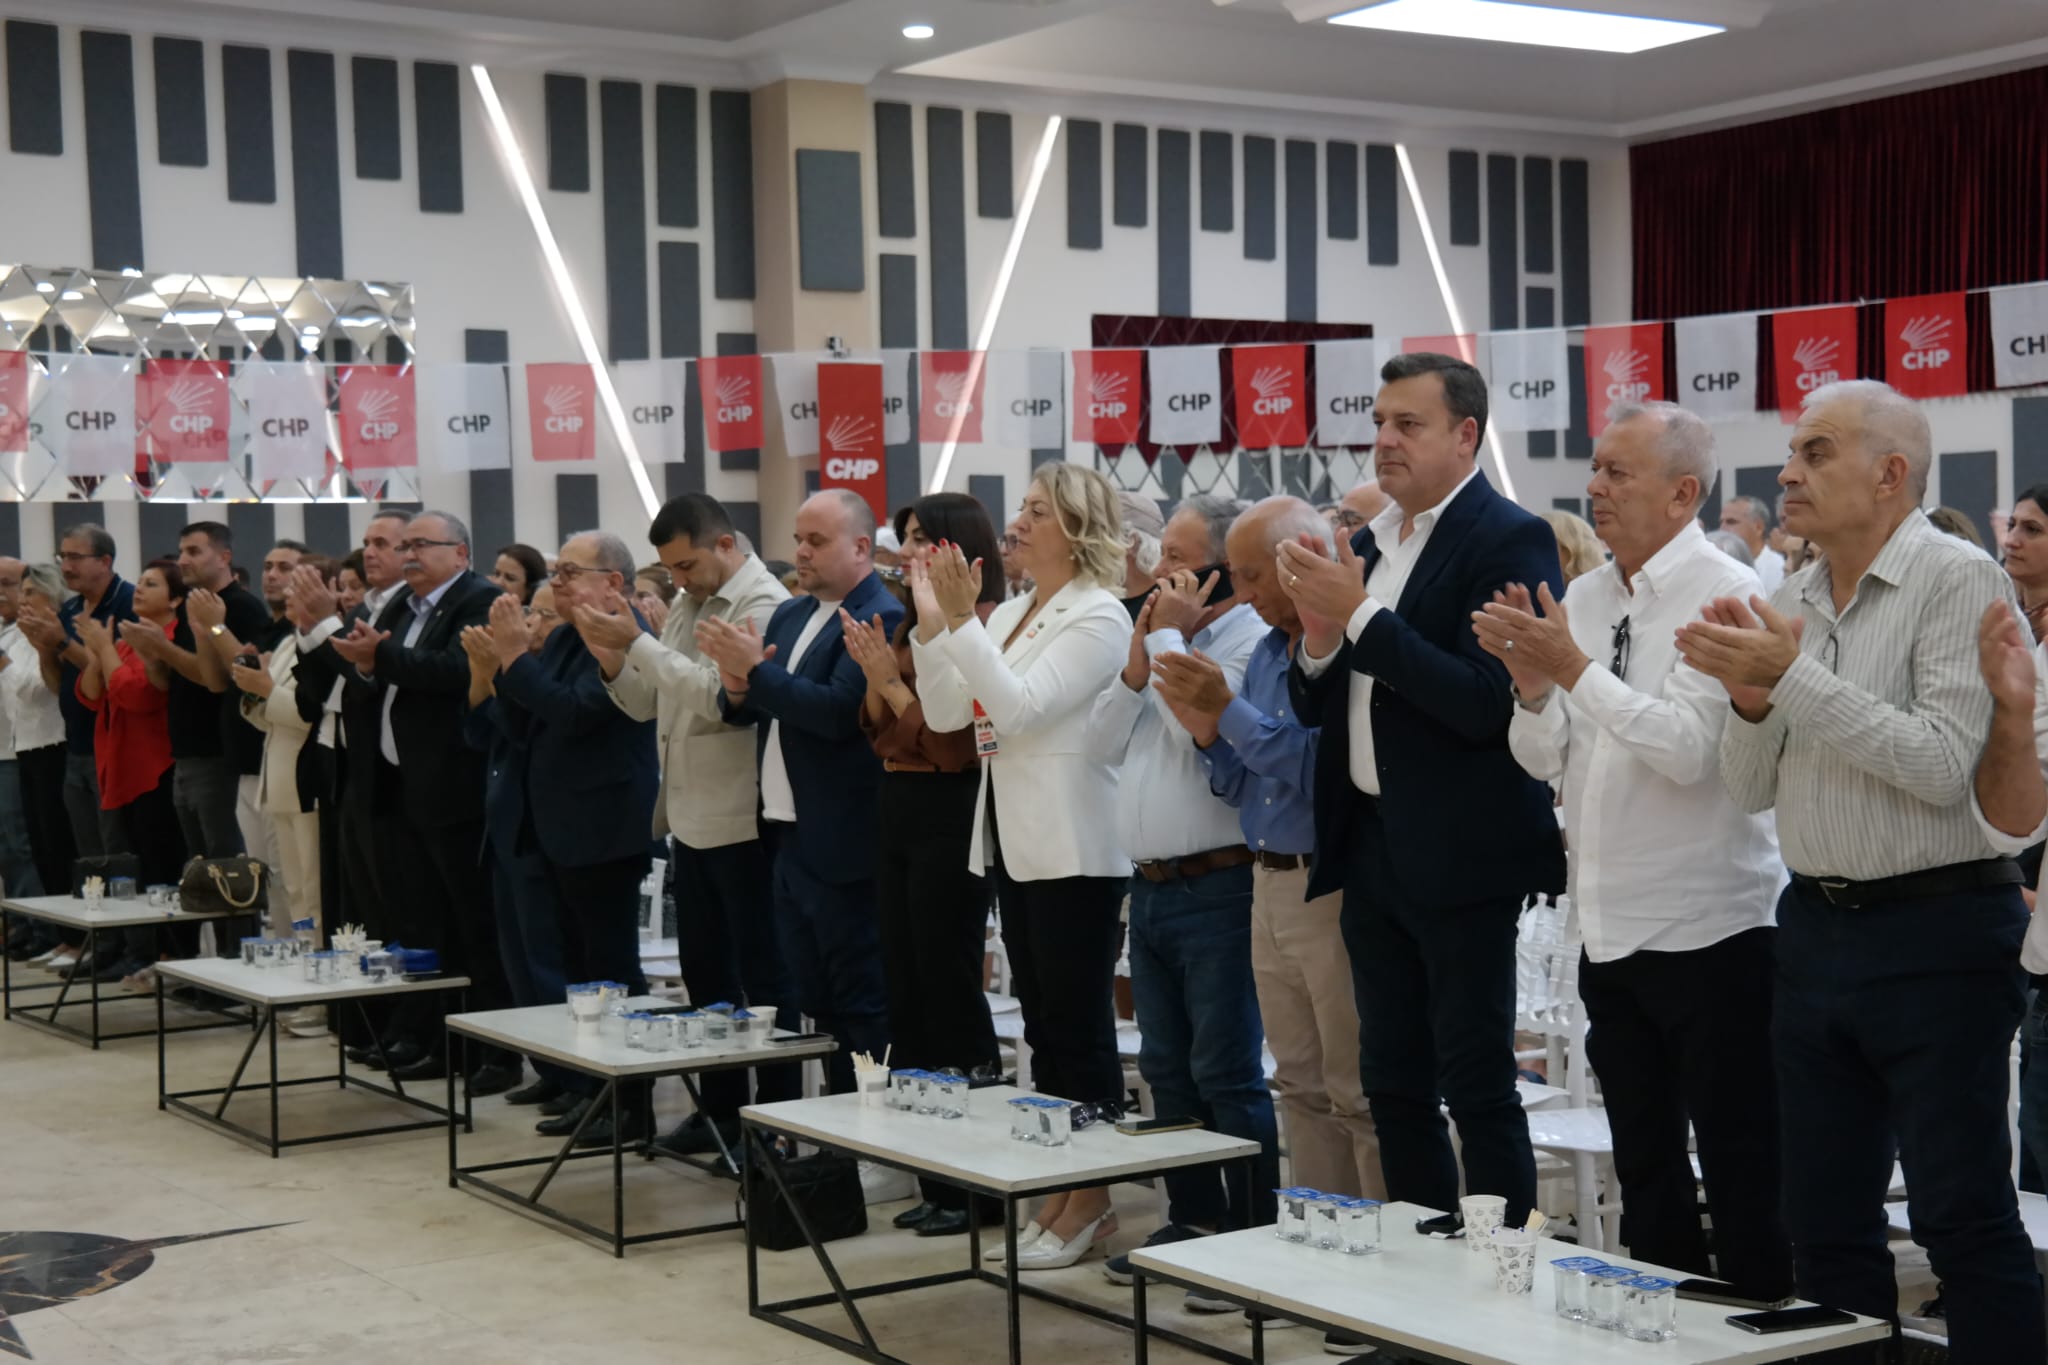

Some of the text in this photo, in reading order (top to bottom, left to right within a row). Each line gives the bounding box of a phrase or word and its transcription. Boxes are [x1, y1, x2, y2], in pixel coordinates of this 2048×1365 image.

[2010, 336, 2048, 356] CH
[1902, 348, 1950, 370] CHP
[1510, 379, 1555, 399] CHP
[1693, 372, 1740, 392] CHP
[1796, 369, 1840, 390] CHP
[1606, 383, 1650, 400] CHP
[791, 403, 818, 419] CH
[934, 401, 973, 418] CHP
[1010, 399, 1052, 417] CHP
[1087, 402, 1127, 419] CHP
[1168, 394, 1211, 412] CHP
[1253, 397, 1293, 416] CHP
[1330, 396, 1374, 415] CHP
[65, 410, 117, 432] CHP
[447, 415, 492, 433] CHP
[545, 415, 583, 433] CHP
[632, 406, 674, 424] CHP
[718, 406, 753, 423] CHP
[169, 415, 213, 434] CHP
[262, 418, 310, 437] CHP
[360, 421, 399, 440] CHP
[826, 458, 879, 480] CHP
